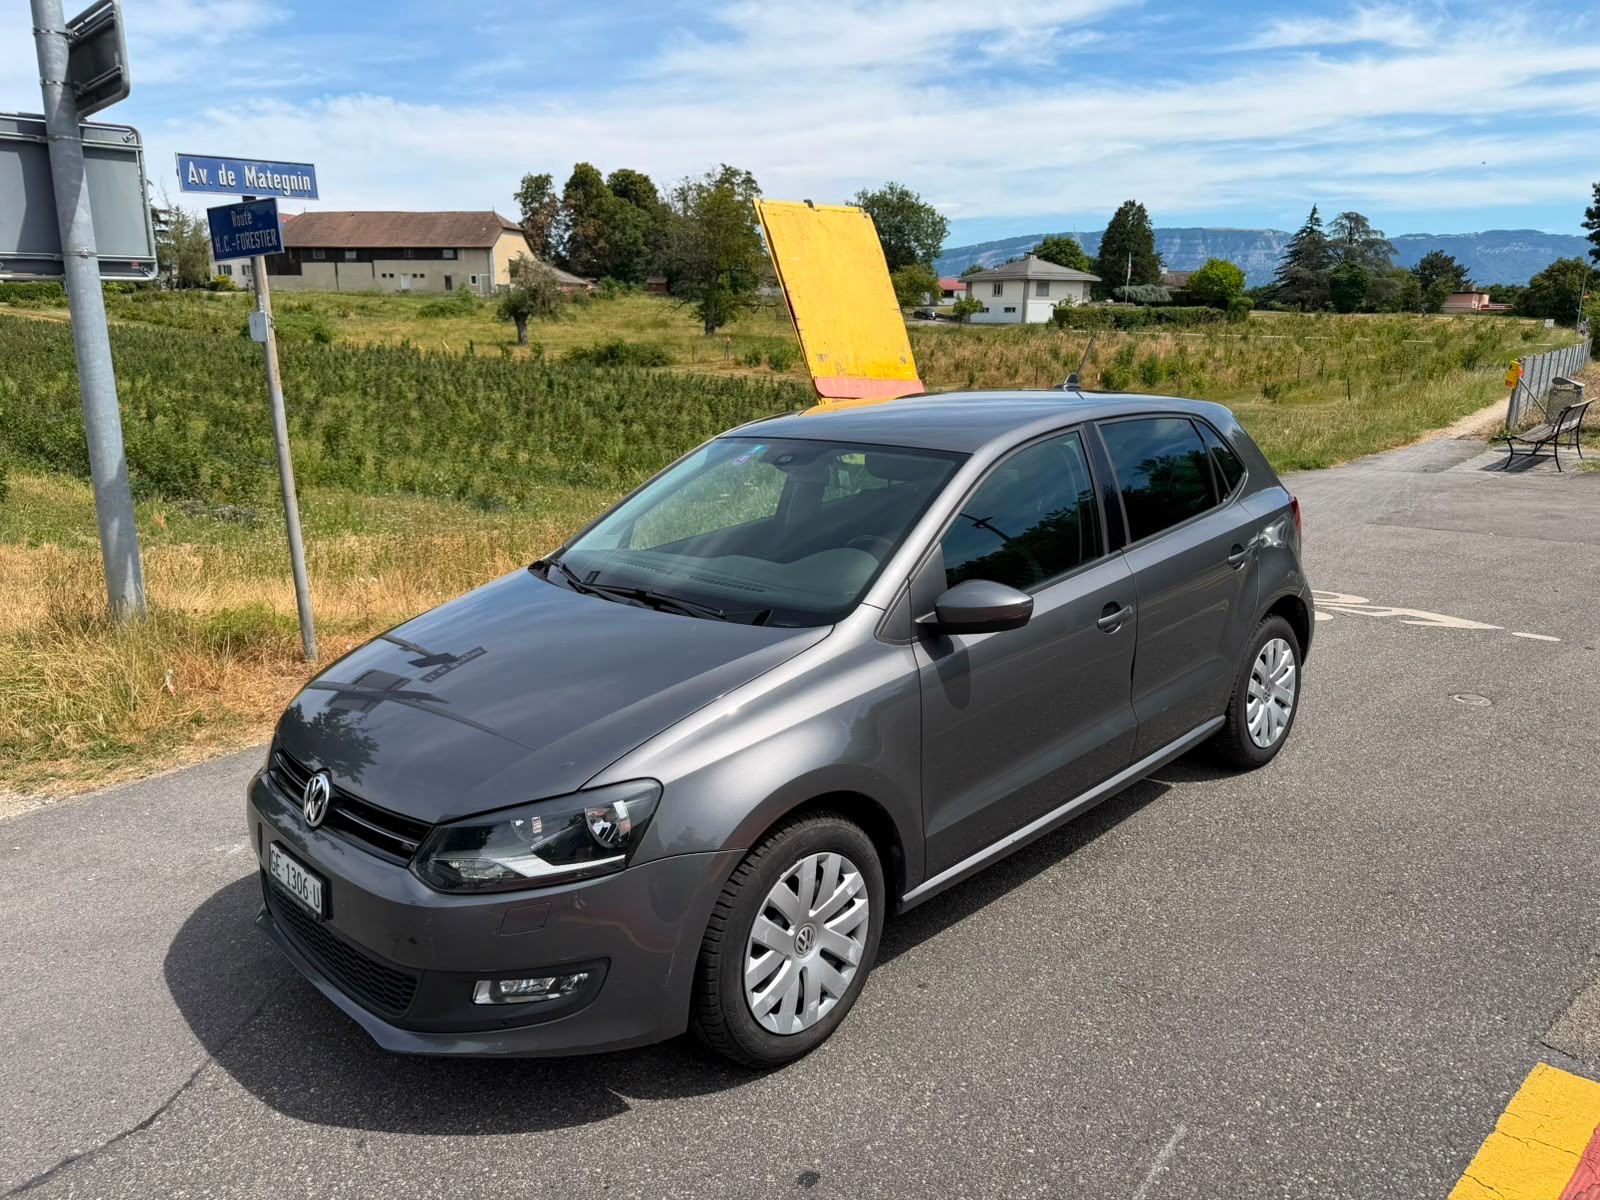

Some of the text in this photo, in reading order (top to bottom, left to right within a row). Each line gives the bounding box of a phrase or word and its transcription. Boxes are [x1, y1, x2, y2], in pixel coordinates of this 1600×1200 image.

[188, 160, 311, 196] Av. de Mategnin
[231, 210, 253, 228] Route
